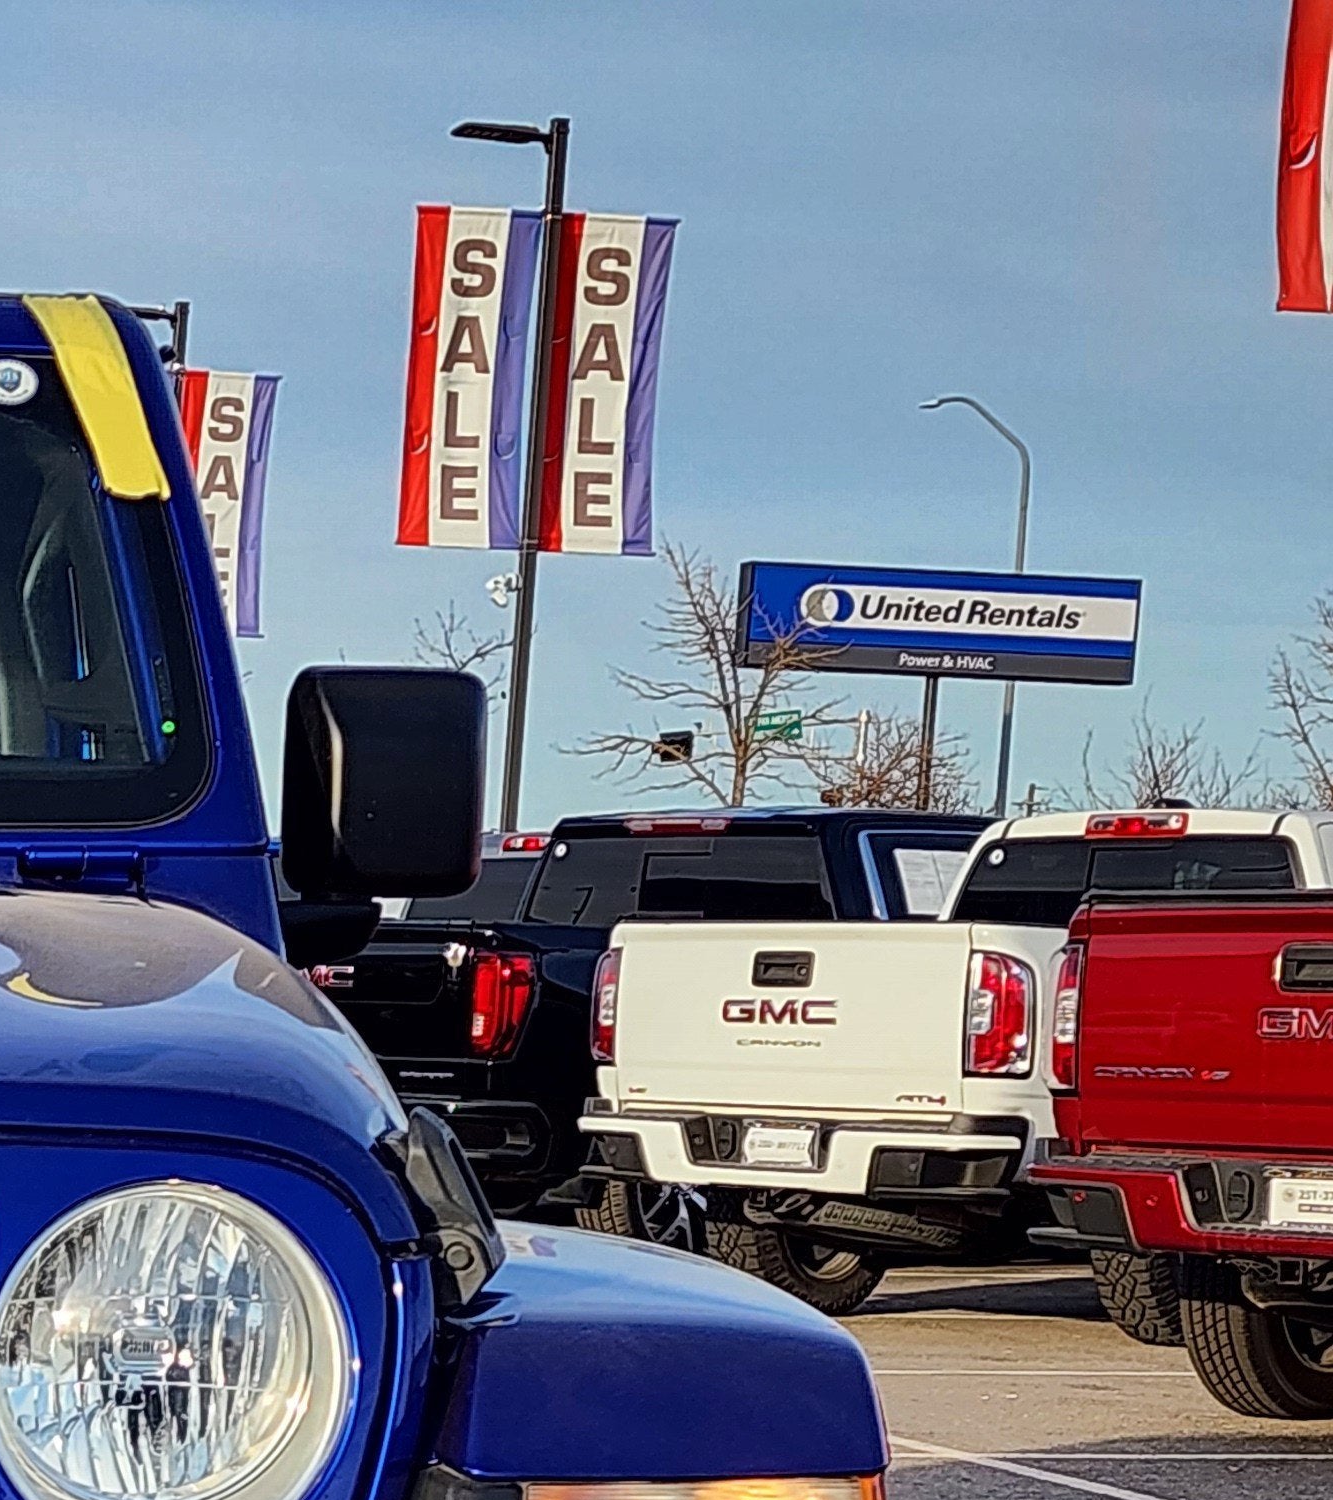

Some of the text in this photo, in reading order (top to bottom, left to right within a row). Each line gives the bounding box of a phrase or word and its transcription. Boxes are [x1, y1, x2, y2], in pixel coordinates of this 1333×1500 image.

[440, 239, 498, 521] SALE
[573, 247, 632, 527] SALE
[201, 397, 245, 618] SAL
[860, 594, 1082, 629] United Rentals
[899, 652, 995, 670] Power & HVAC
[722, 999, 838, 1025] GMC
[1256, 1007, 1333, 1038] GM
